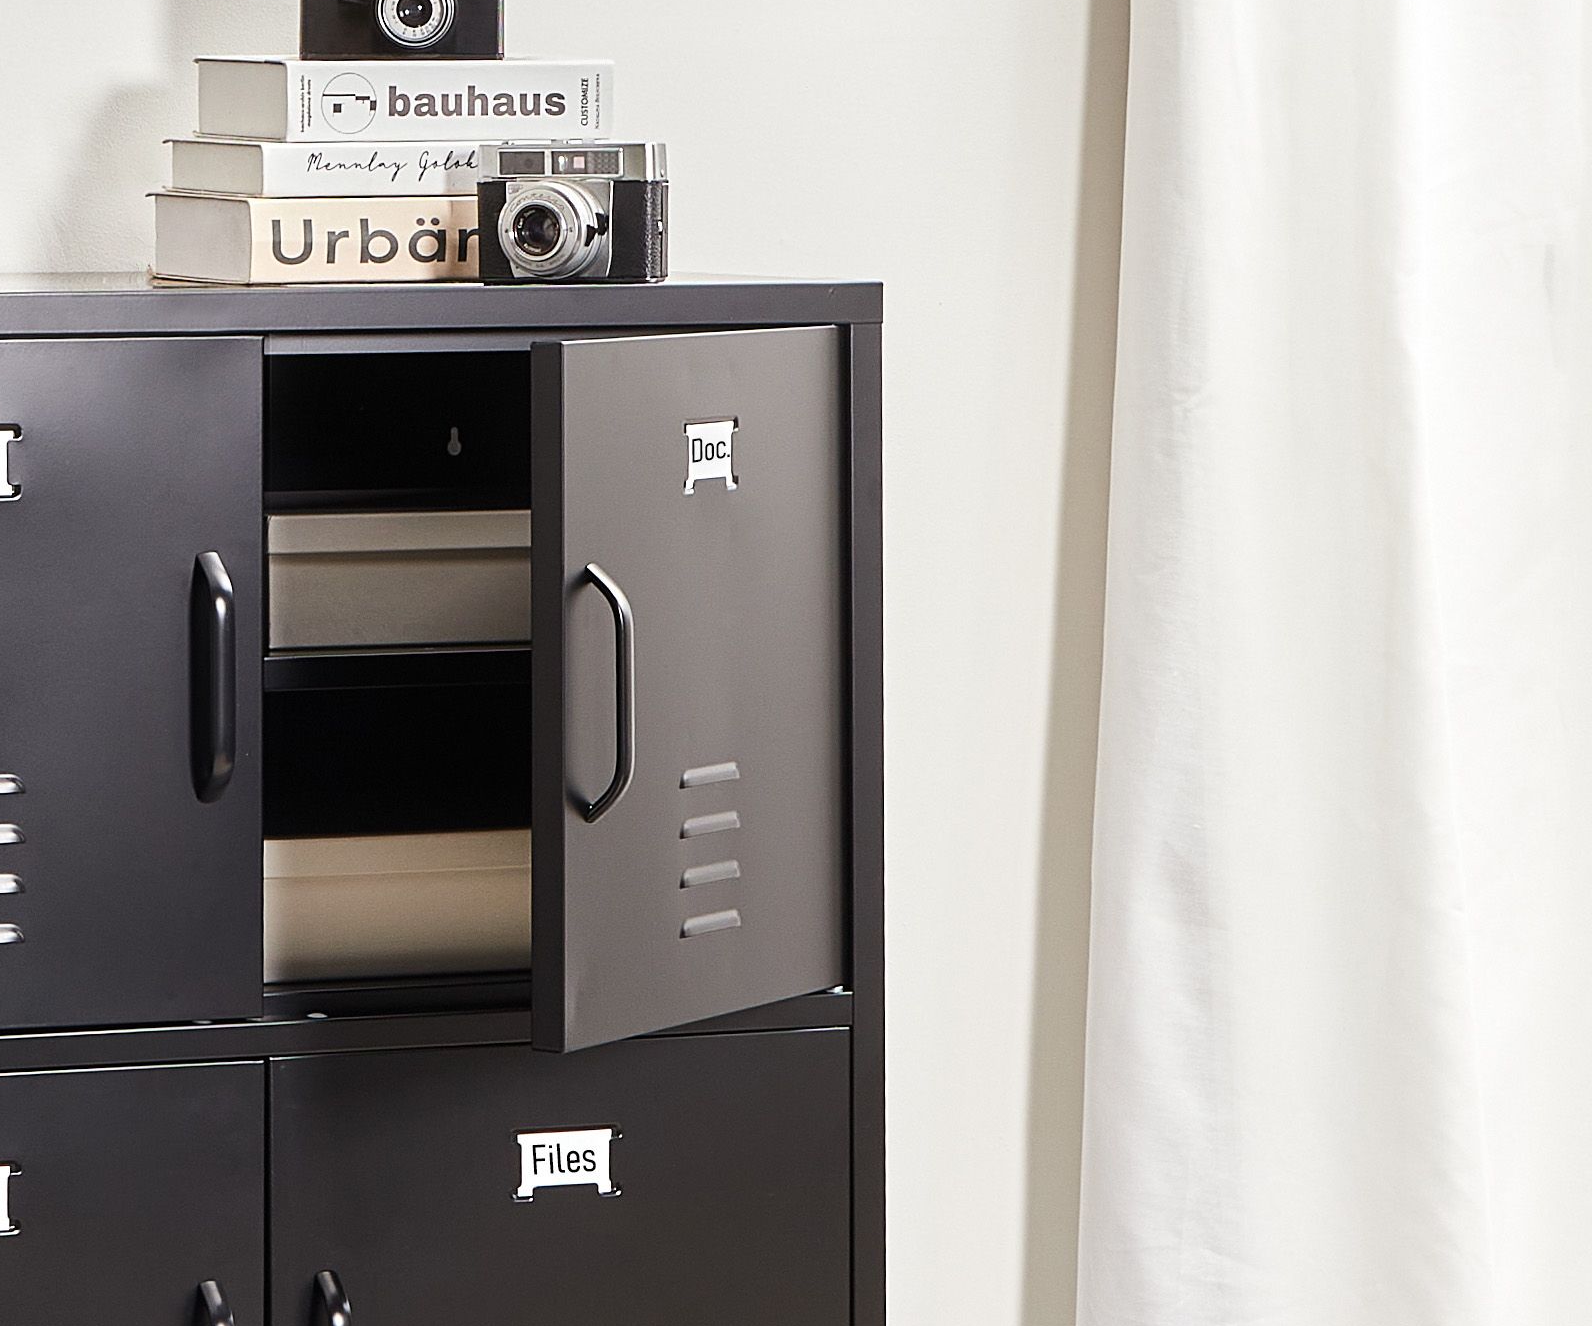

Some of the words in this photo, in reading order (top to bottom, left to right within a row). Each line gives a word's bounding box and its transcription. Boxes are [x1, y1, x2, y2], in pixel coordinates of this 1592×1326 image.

[388, 85, 566, 117] bauhaus
[580, 77, 589, 126] CUSTOMIZE
[691, 437, 731, 463] Doc.
[532, 1143, 597, 1175] Files
